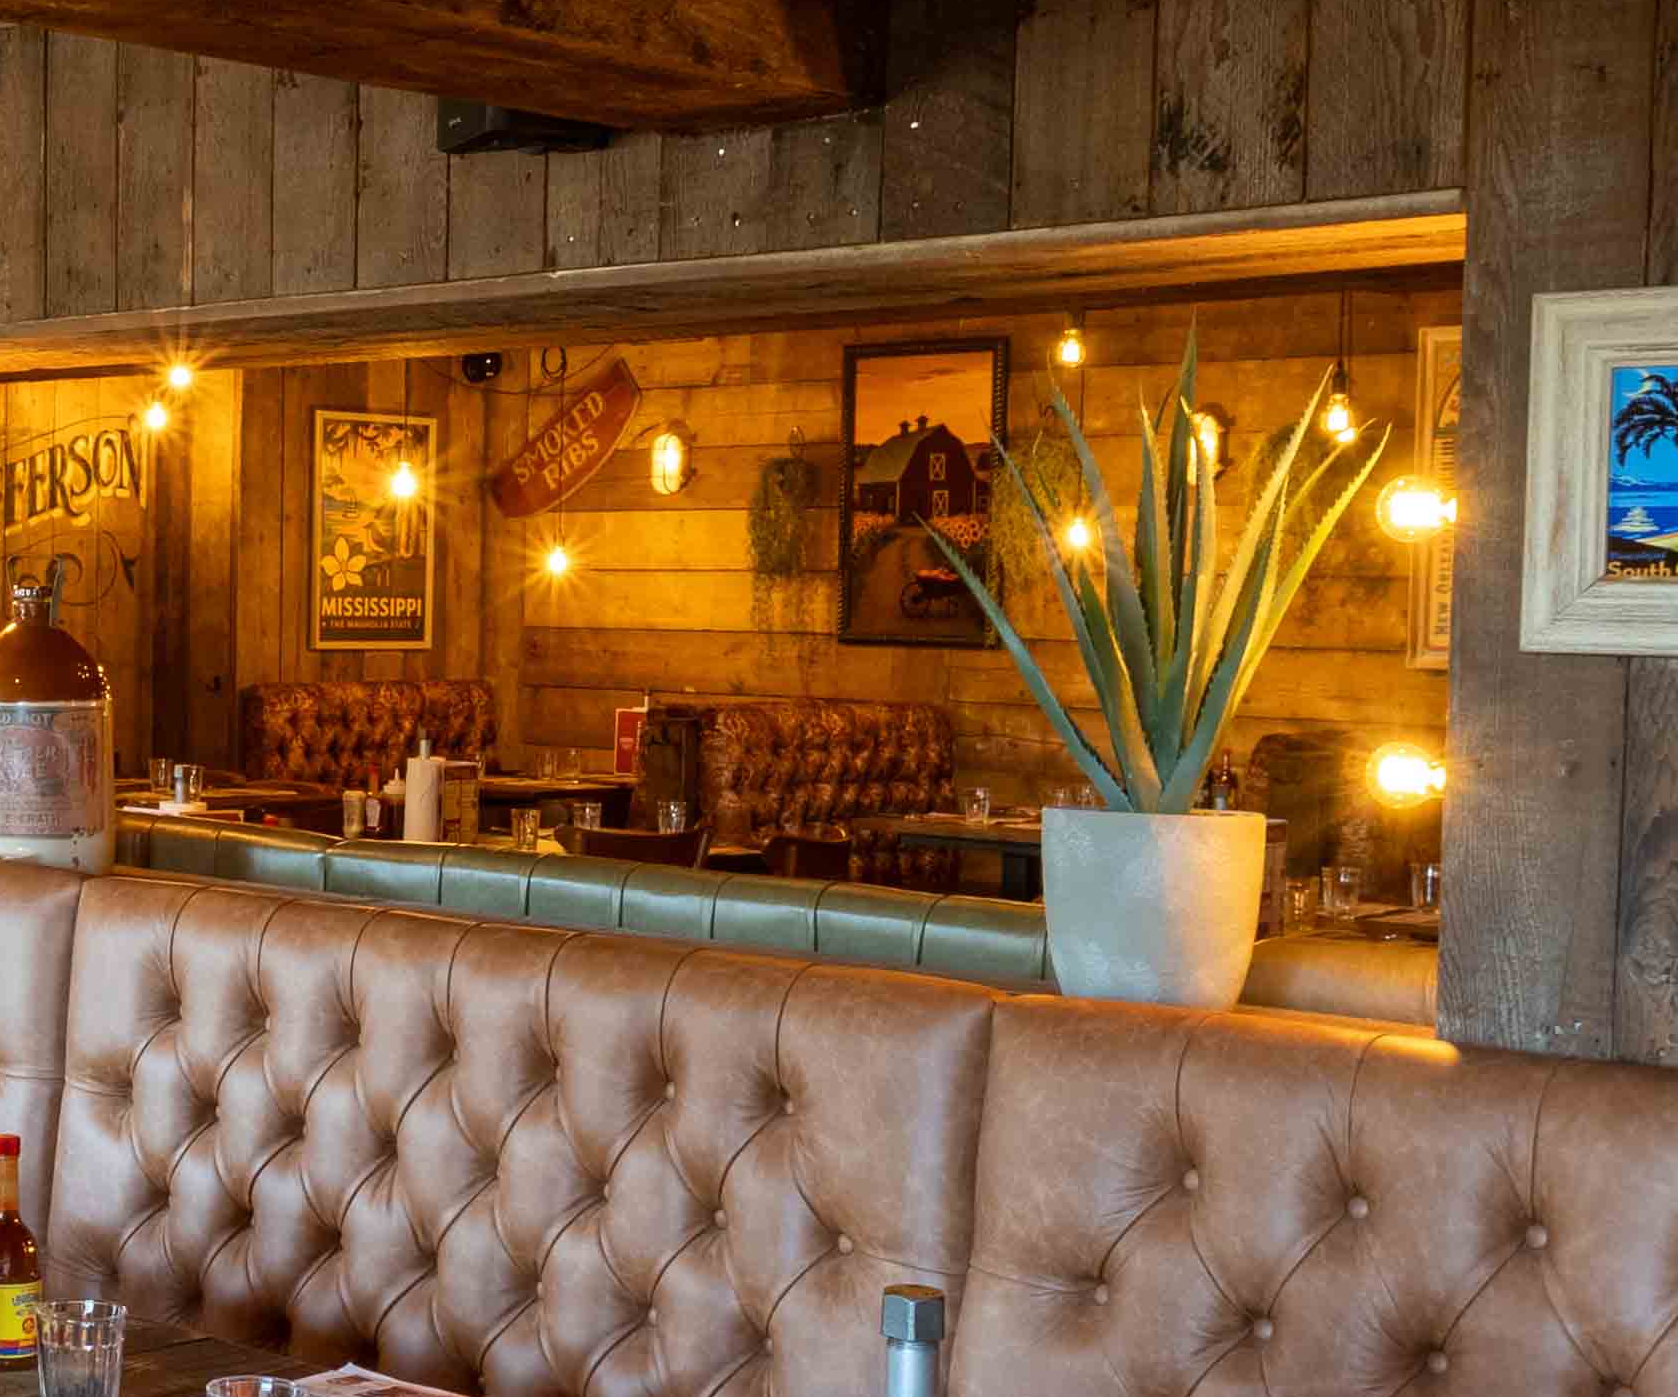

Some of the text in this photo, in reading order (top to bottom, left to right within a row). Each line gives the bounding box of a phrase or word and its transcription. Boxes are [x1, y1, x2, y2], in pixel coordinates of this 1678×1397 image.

[512, 391, 604, 485] SMOKED
[542, 430, 599, 491] RIBS
[1607, 561, 1671, 579] South
[321, 596, 423, 618] MISSISSIPPI
